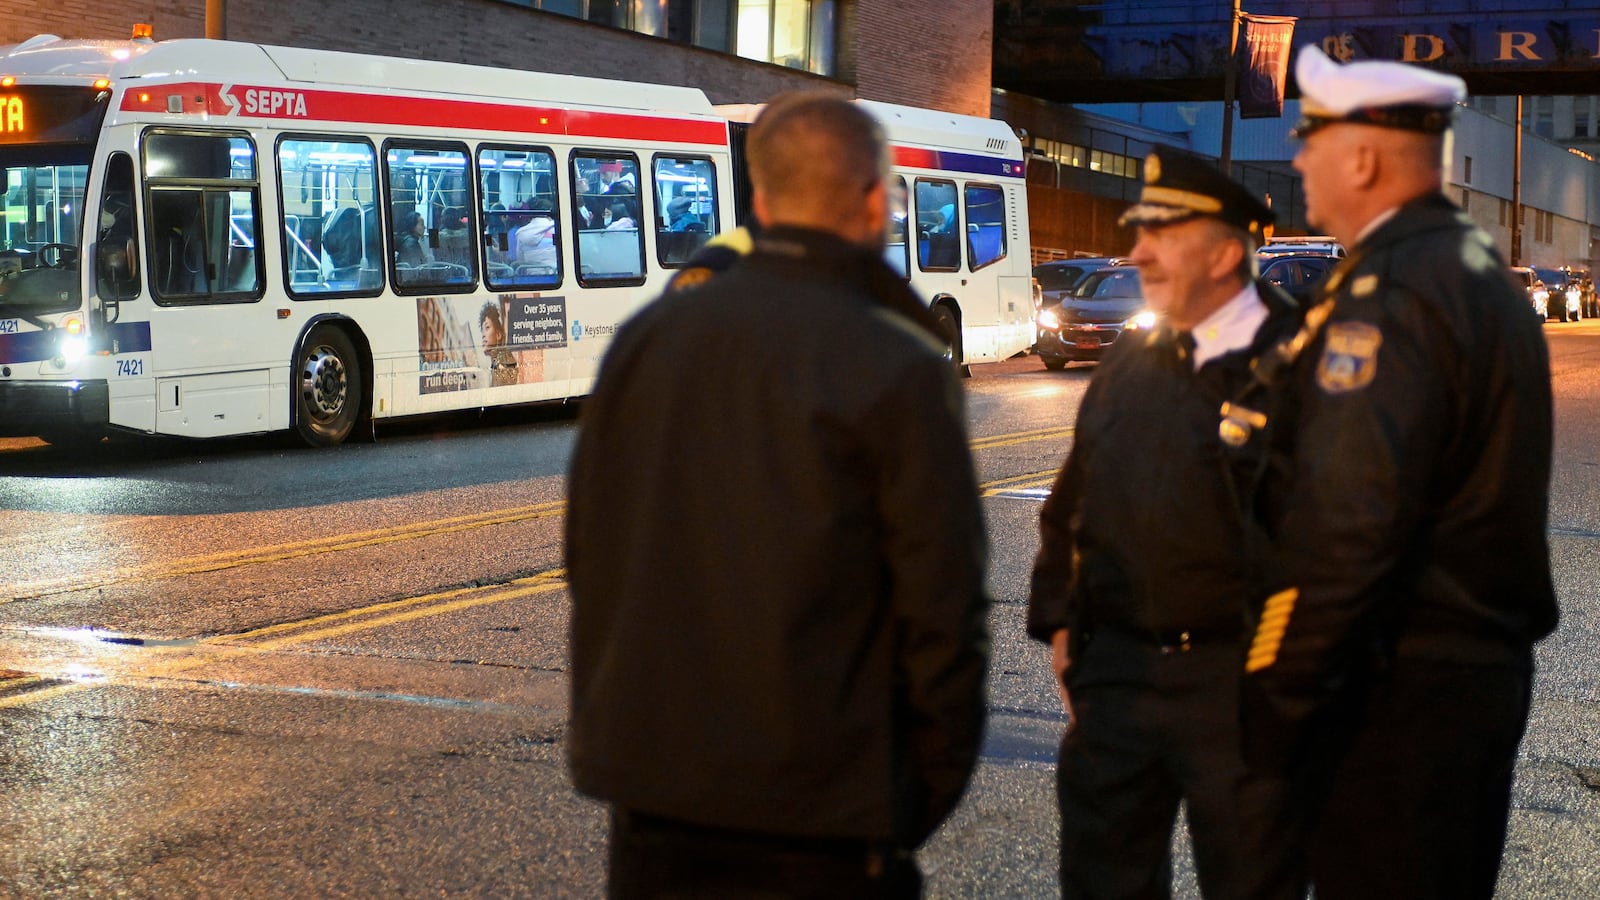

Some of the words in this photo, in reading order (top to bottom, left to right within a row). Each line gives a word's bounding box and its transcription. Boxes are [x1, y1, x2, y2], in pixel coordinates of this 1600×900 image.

[245, 89, 308, 116] SEPTA
[523, 304, 538, 315] Over
[538, 303, 546, 313] 35
[546, 304, 562, 315] years
[0, 320, 19, 333] 421
[513, 318, 535, 330] serving
[535, 317, 563, 330] neighbors,
[512, 332, 534, 344] friends,
[534, 332, 545, 342] and
[545, 330, 564, 343] family.
[584, 325, 613, 338] Keystone
[116, 359, 143, 376] 7421
[425, 375, 441, 387] run
[442, 370, 466, 391] deep.
